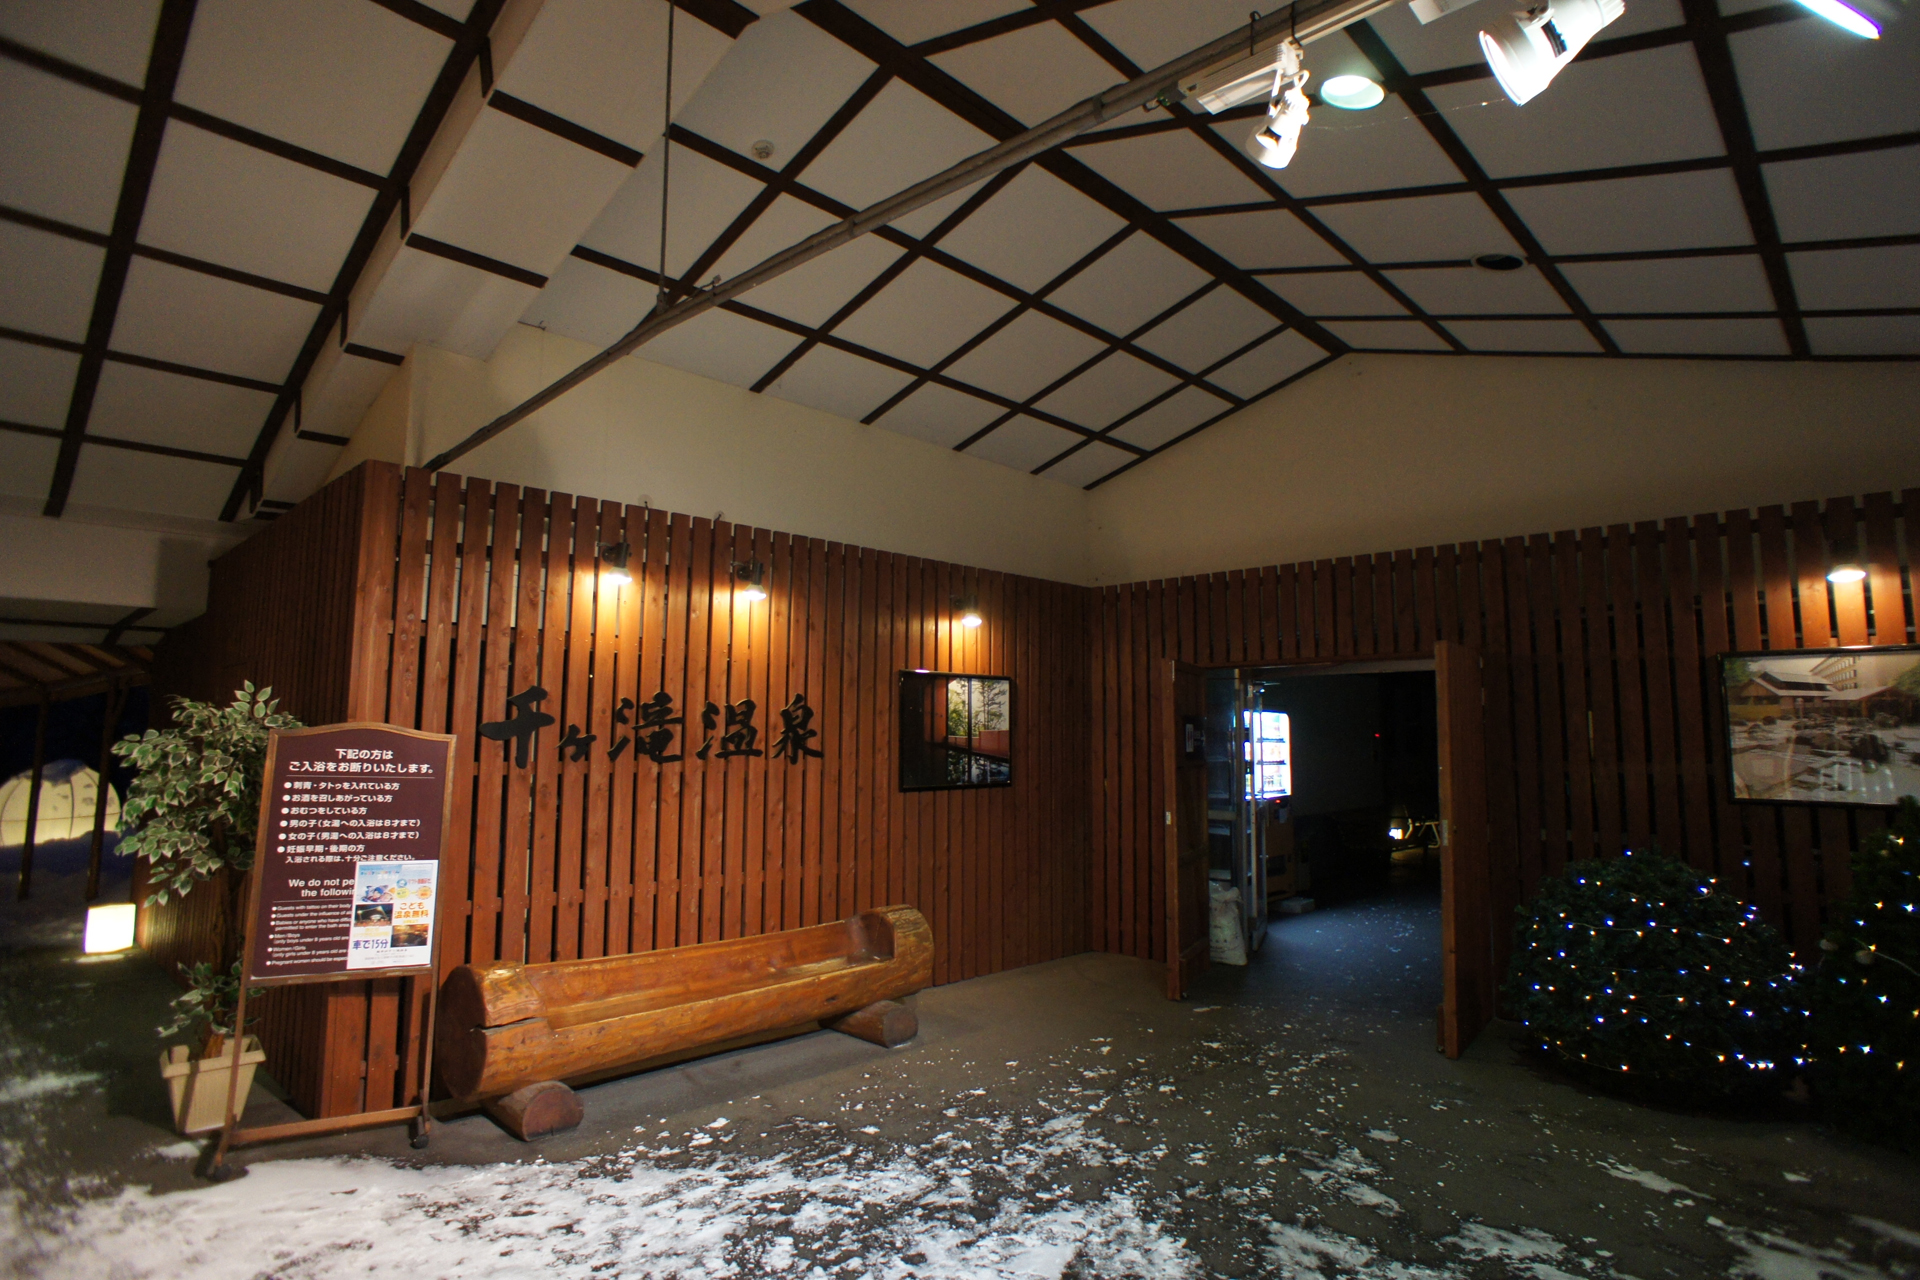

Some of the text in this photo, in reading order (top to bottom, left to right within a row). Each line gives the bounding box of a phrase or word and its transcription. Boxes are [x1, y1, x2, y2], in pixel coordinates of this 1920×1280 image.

[335, 748, 394, 760] 下記の方は
[288, 761, 434, 774] ご入浴をお断りいたします。
[291, 794, 393, 803] お酒を召しあがっている方
[289, 807, 368, 816] おむつをしている方
[288, 878, 305, 888] We
[308, 878, 321, 887] do
[323, 878, 340, 886] not
[301, 889, 317, 897] the
[399, 902, 425, 910] こども
[352, 938, 389, 950] 車で15分
